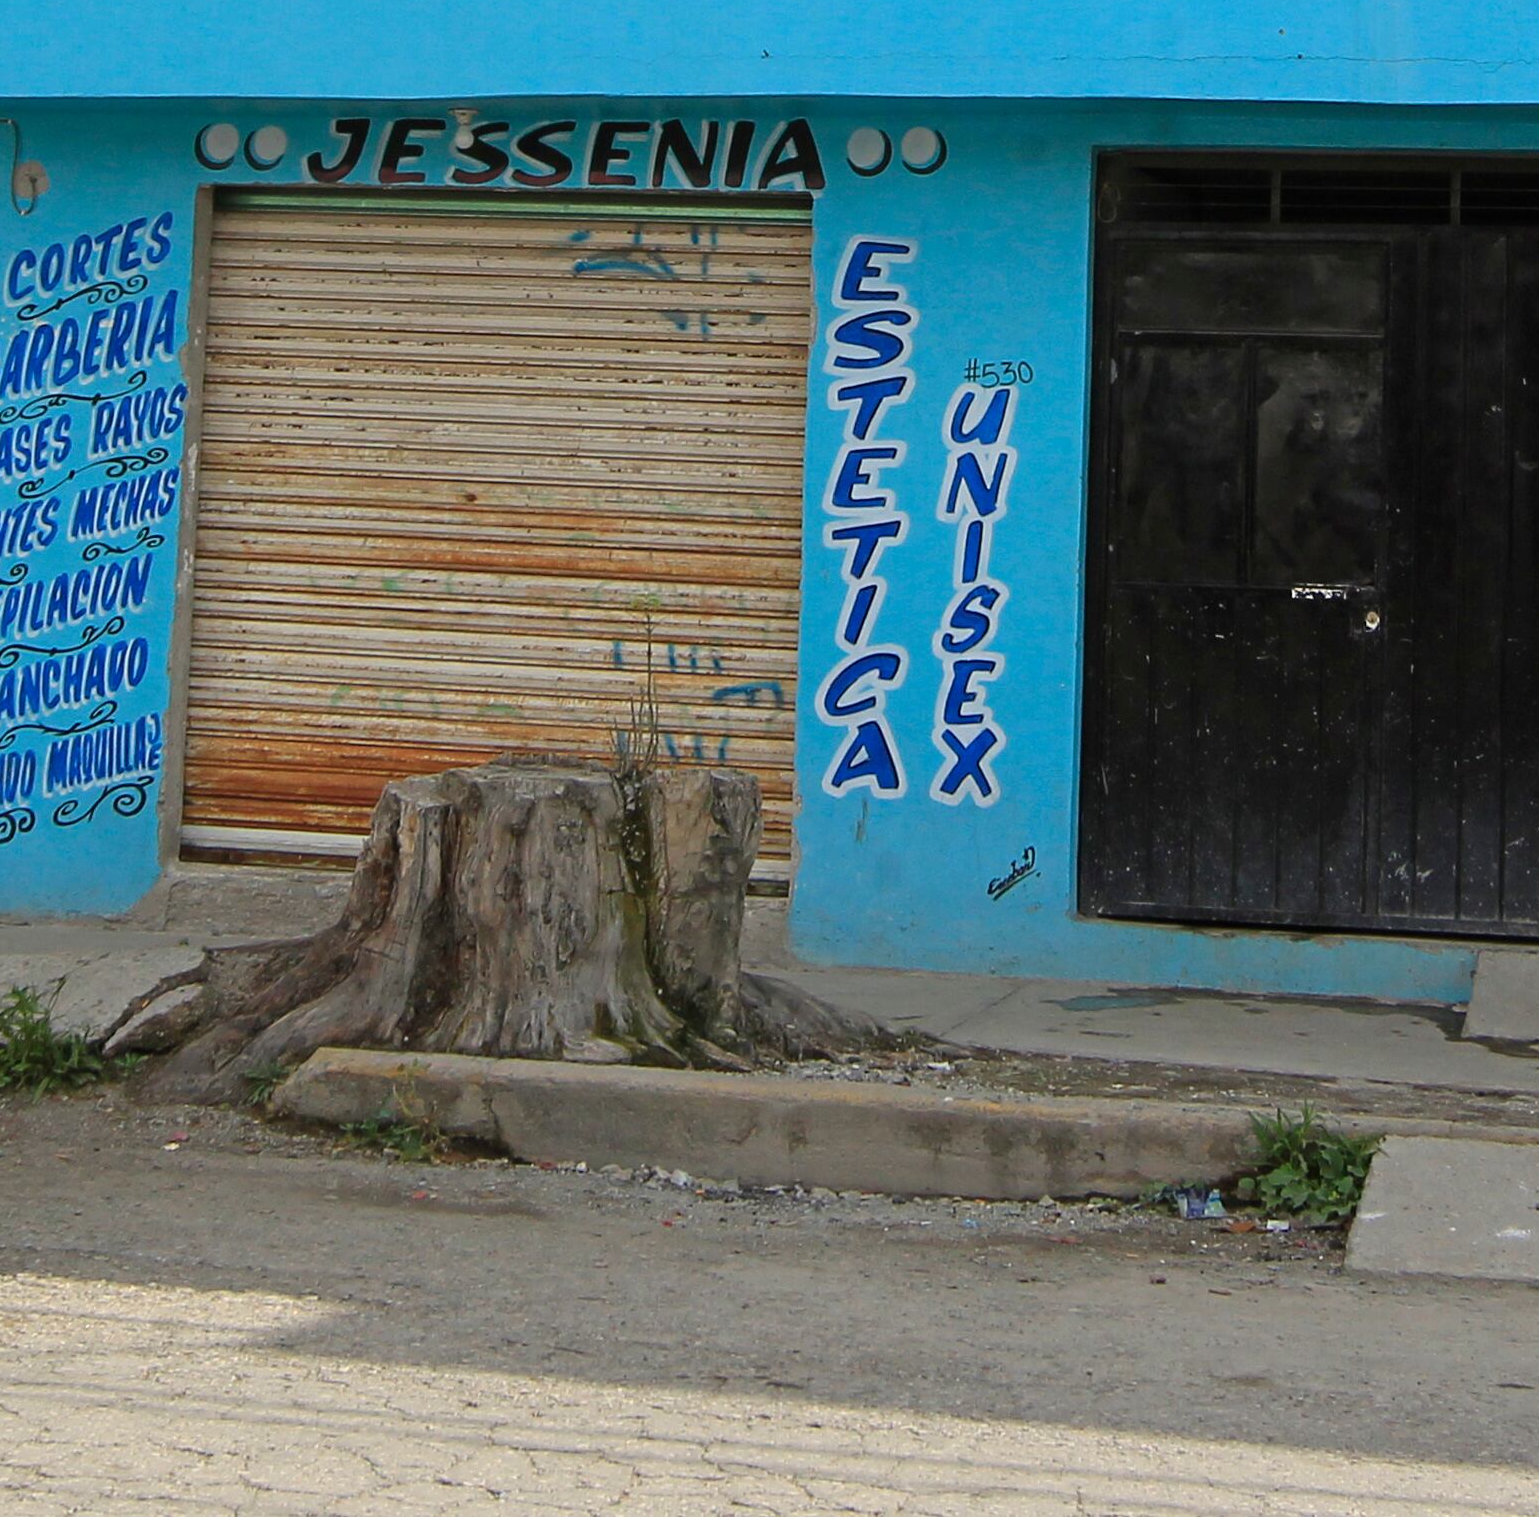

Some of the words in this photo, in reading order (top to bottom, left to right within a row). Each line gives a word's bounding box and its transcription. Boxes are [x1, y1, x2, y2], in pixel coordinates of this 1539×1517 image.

[305, 116, 827, 191] JESSENIA
[6, 211, 174, 305] CORTES
[963, 357, 1034, 388] #530
[89, 382, 188, 457] RAYOS
[67, 466, 179, 542] MECHAS
[819, 238, 914, 795] ESTETICA
[937, 384, 1018, 803] UNISEX
[44, 712, 162, 796] MAQUILLAJE
